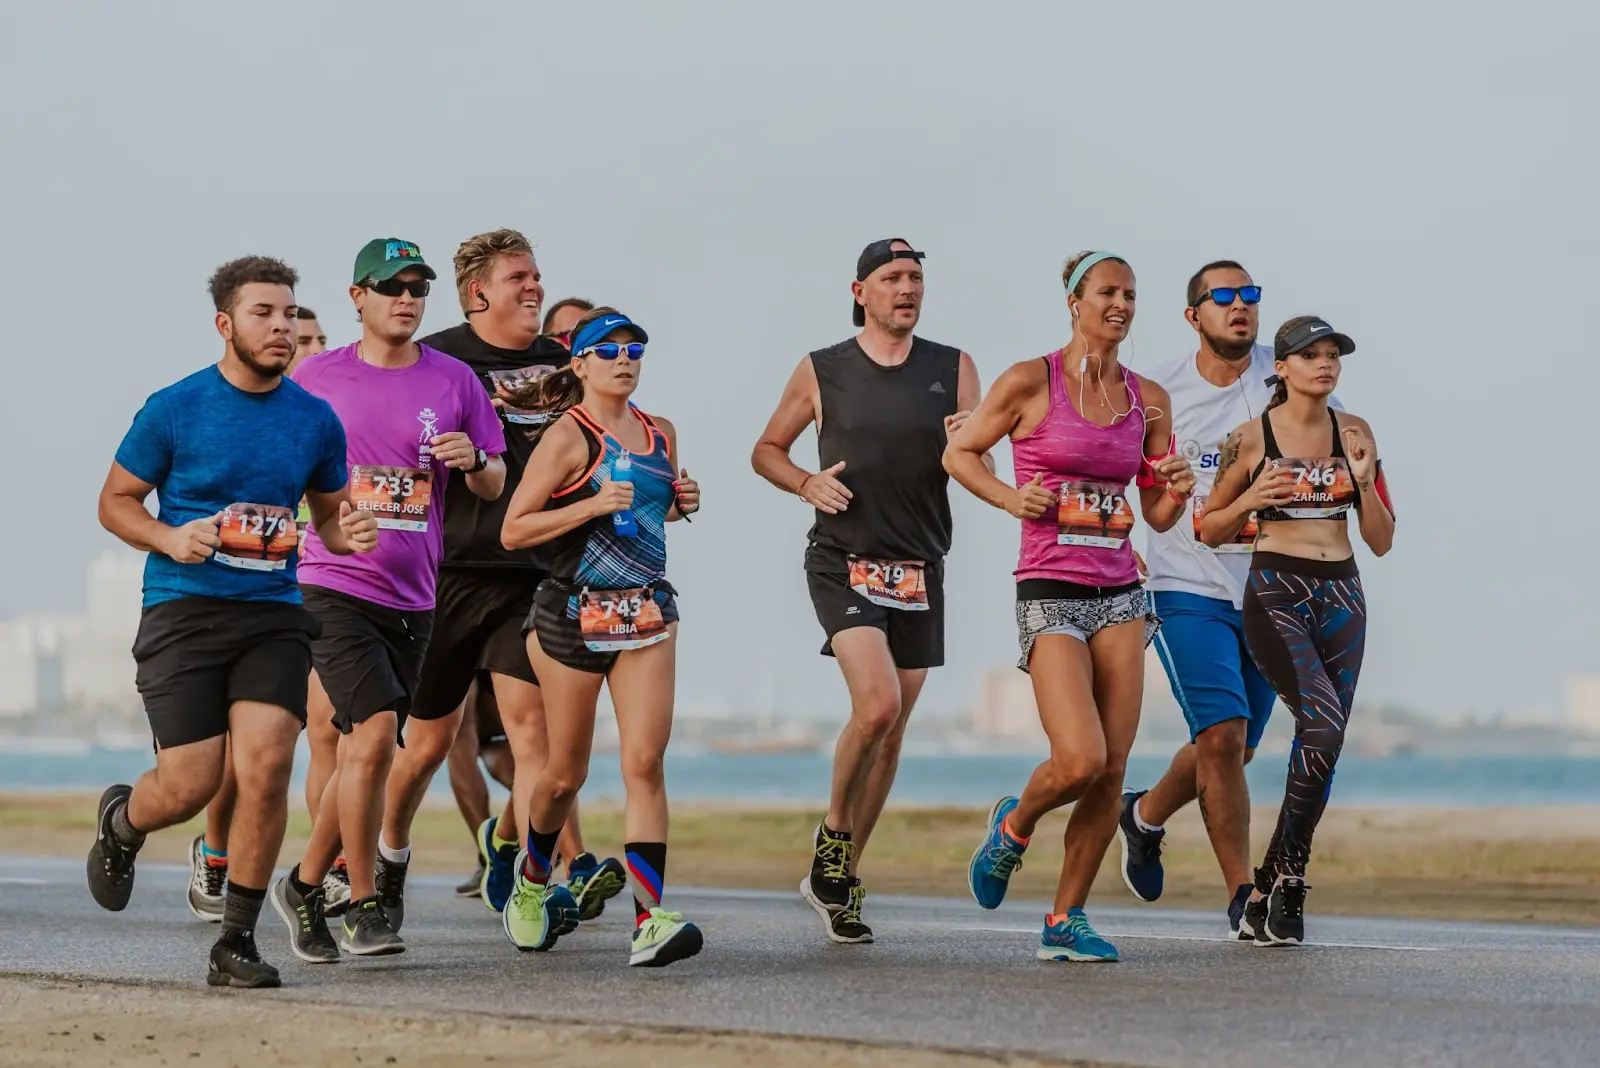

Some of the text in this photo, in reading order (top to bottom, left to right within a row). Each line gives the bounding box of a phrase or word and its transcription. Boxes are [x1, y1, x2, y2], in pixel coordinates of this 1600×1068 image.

[372, 475, 414, 497] 733
[1293, 467, 1336, 487] 746
[1076, 492, 1125, 516] 1242
[1293, 492, 1334, 502] ZAHIRA
[357, 500, 425, 515] ELIECER JOSE
[238, 514, 287, 538] 1279
[867, 563, 905, 584] 219
[869, 584, 907, 599] PATRICK
[600, 598, 642, 619] 743
[609, 623, 638, 635] LIBIA
